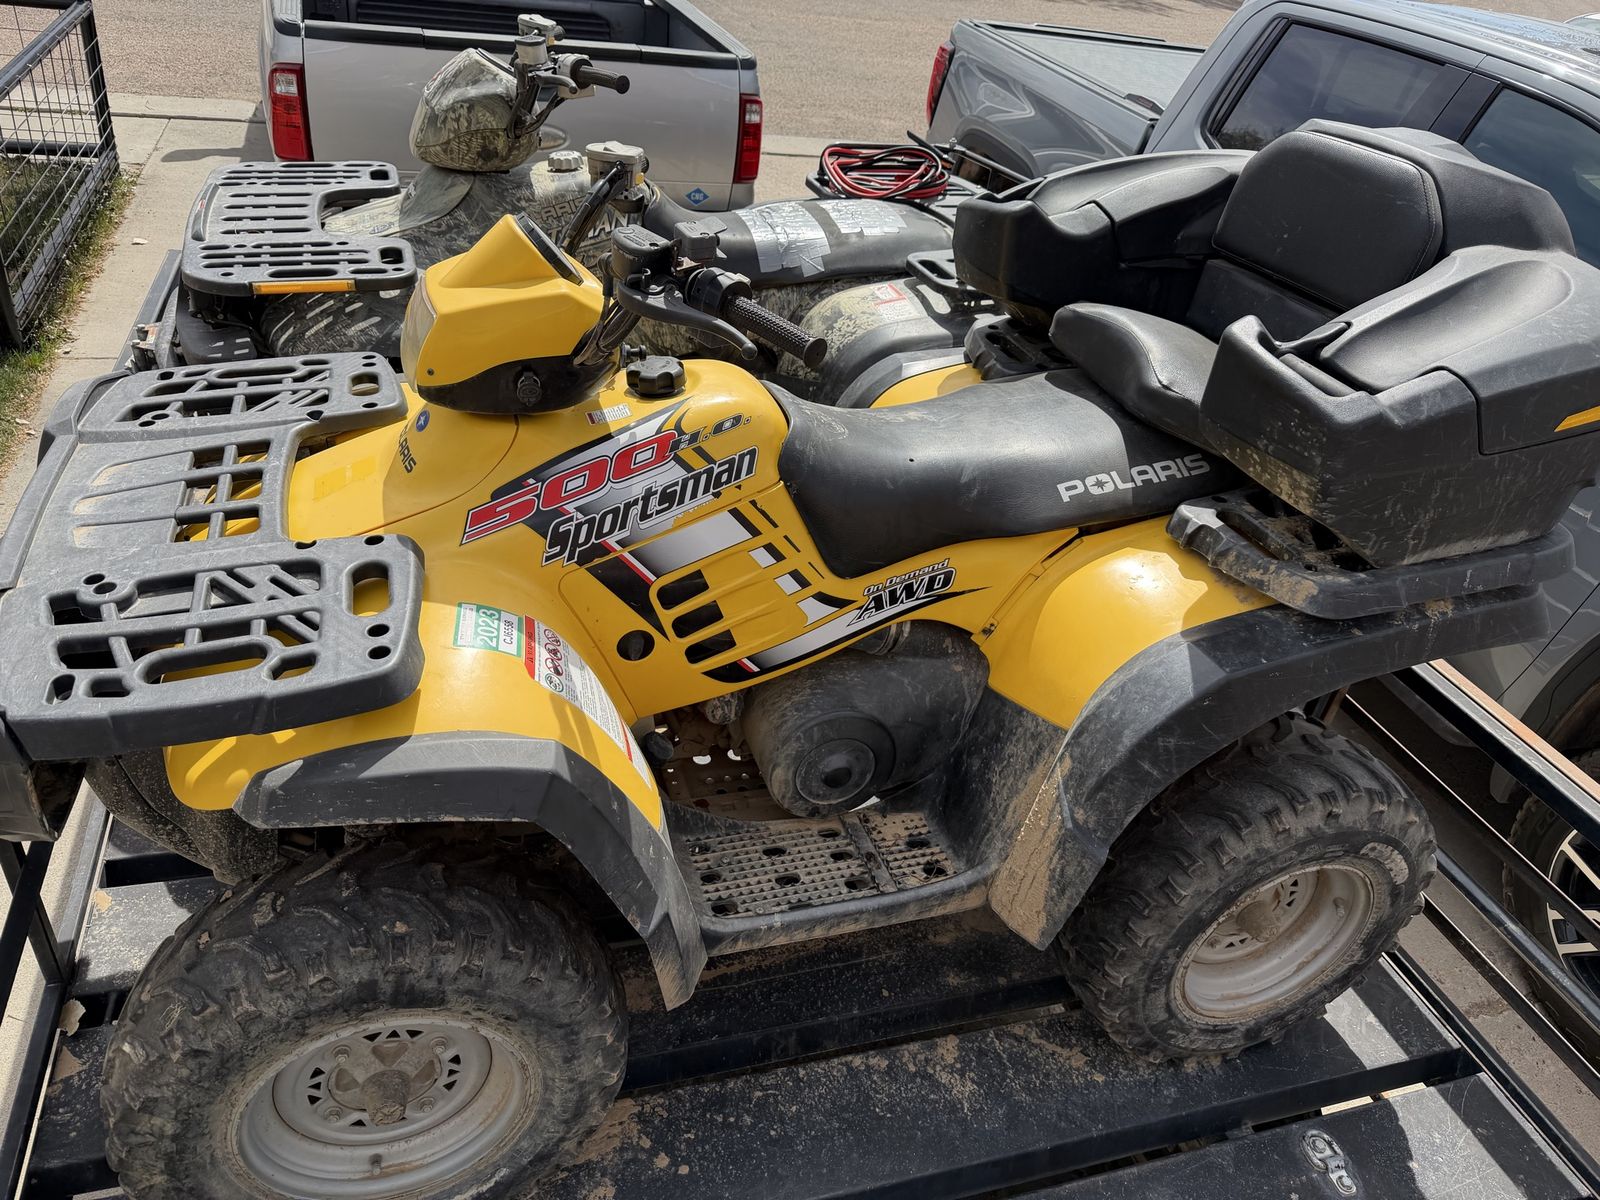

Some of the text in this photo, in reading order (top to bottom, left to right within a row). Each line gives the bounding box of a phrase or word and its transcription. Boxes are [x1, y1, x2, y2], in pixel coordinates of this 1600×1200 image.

[460, 430, 677, 546] 500
[1057, 453, 1210, 502] POLARIS
[541, 446, 758, 567] Sportsman
[847, 567, 956, 626] AWD
[863, 558, 950, 596] On Demand
[477, 609, 499, 647] 2023
